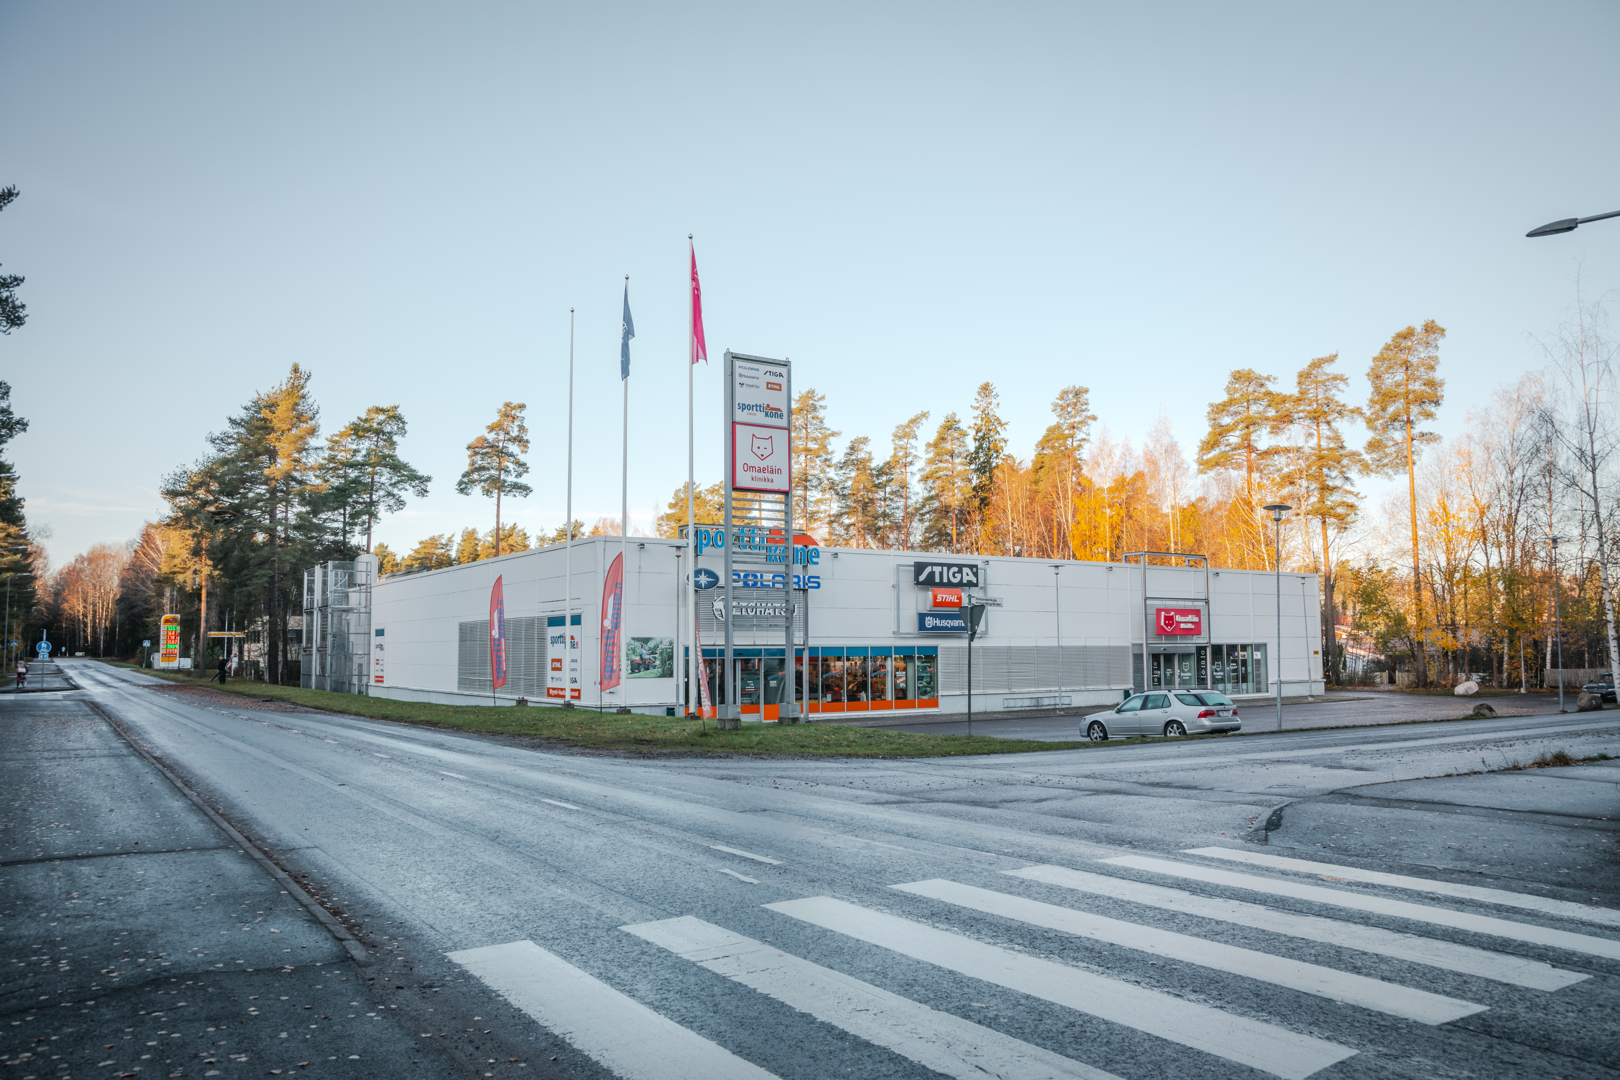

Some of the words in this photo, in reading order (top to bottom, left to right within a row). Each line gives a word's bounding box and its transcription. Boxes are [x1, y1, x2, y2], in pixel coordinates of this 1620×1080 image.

[763, 370, 785, 378] STIGA
[742, 462, 783, 475] Omaeläin
[750, 475, 774, 483] klinikka
[918, 565, 977, 584] STIGA
[935, 594, 960, 603] STIHL
